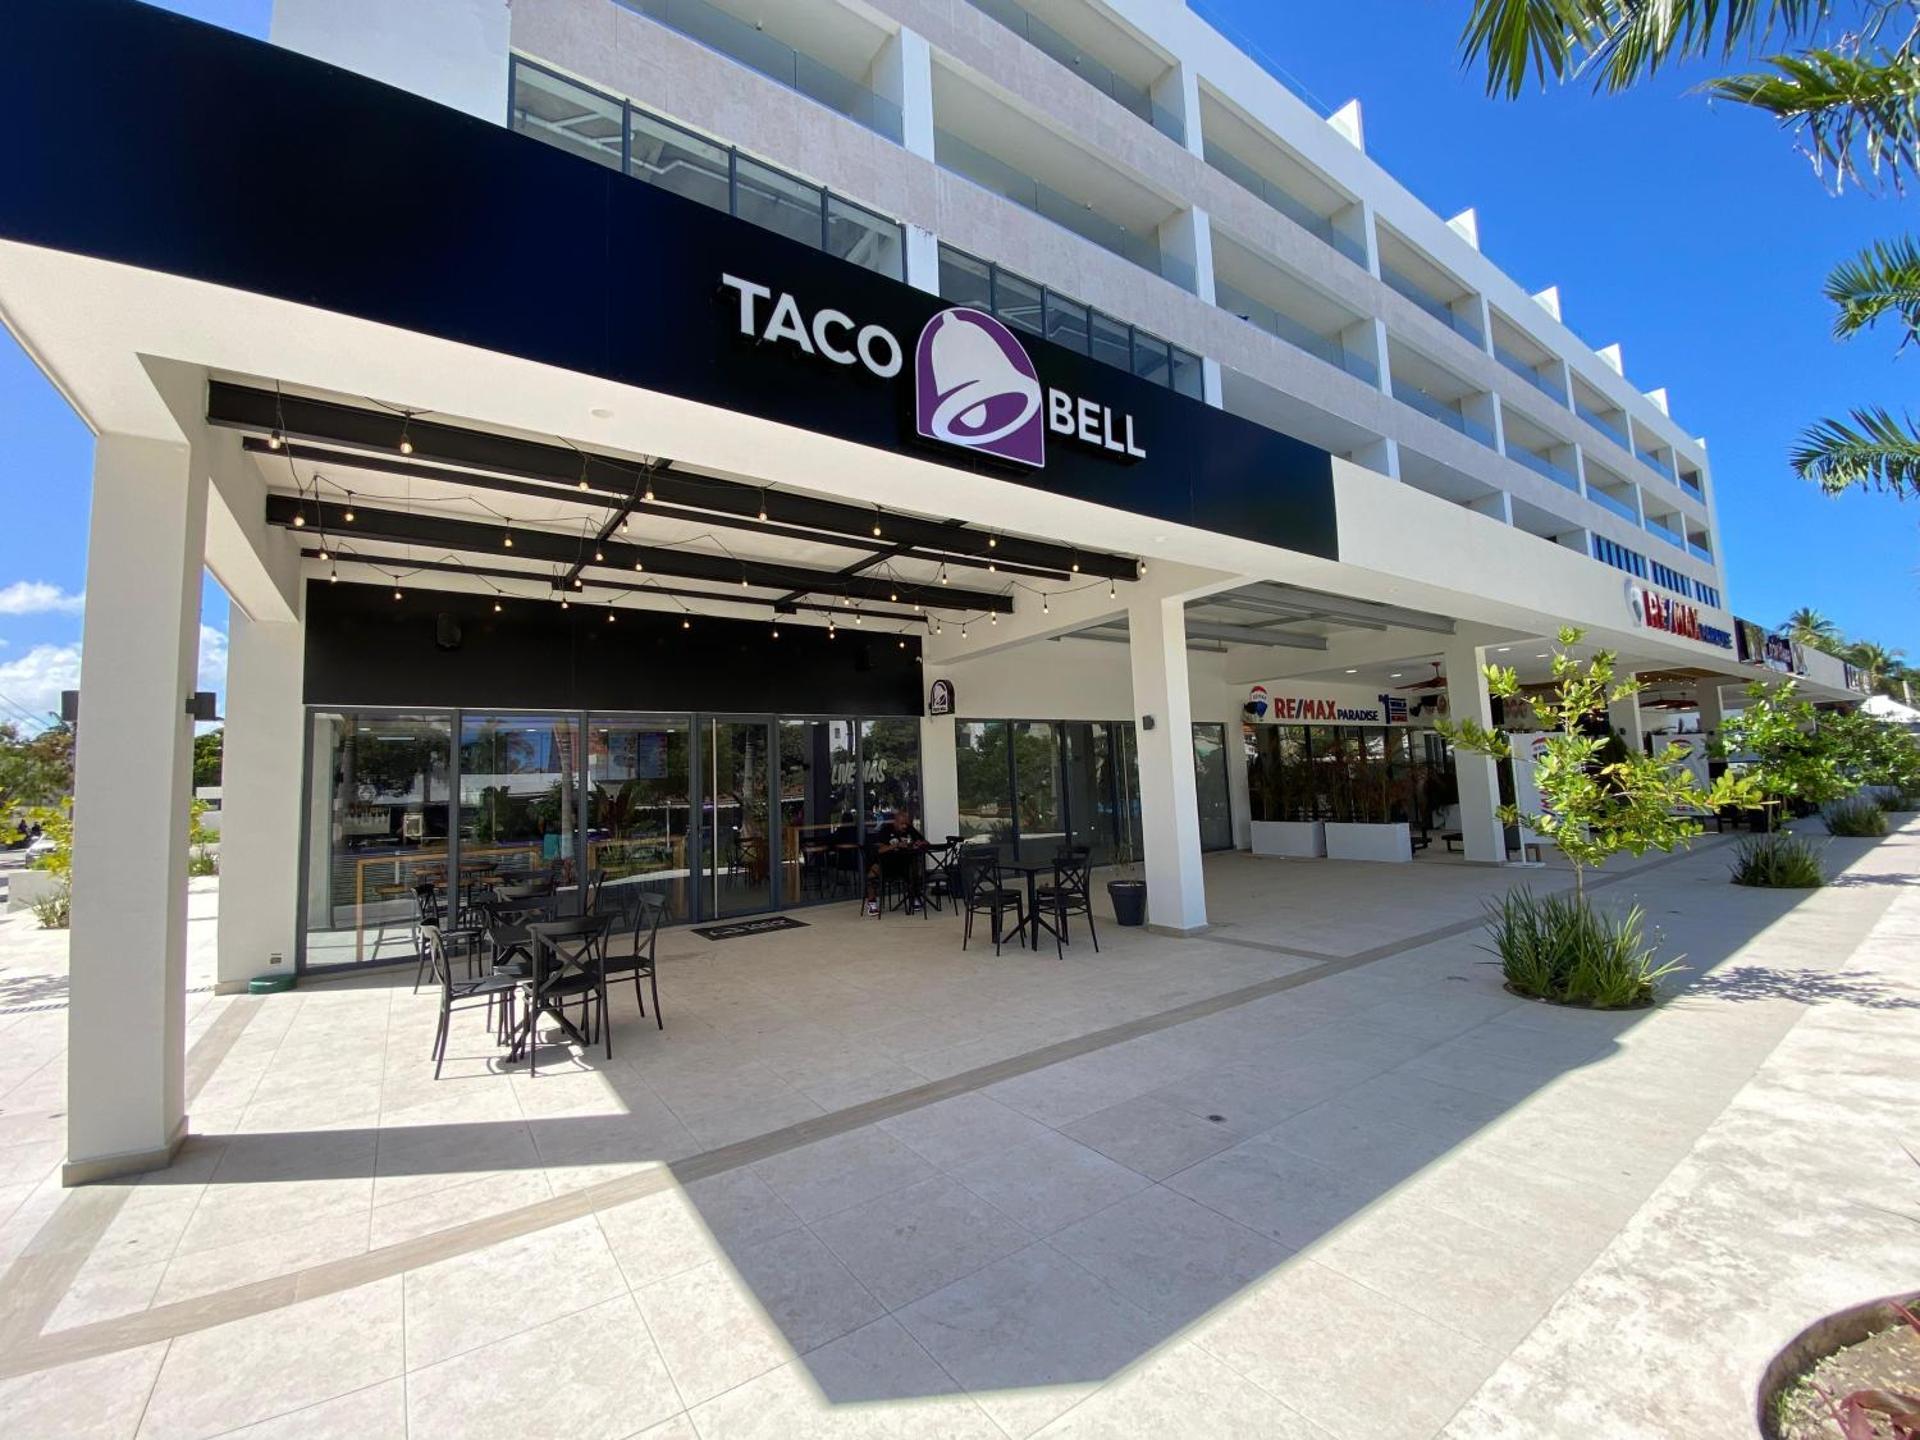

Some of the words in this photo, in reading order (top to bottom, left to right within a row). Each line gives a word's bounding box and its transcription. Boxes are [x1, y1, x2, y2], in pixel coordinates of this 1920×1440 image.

[722, 272, 903, 378] TACO
[1049, 386, 1146, 459] BELL
[1274, 698, 1336, 720] RE/MAX
[1337, 709, 1379, 721] PARADISE
[831, 761, 856, 785] LIVE
